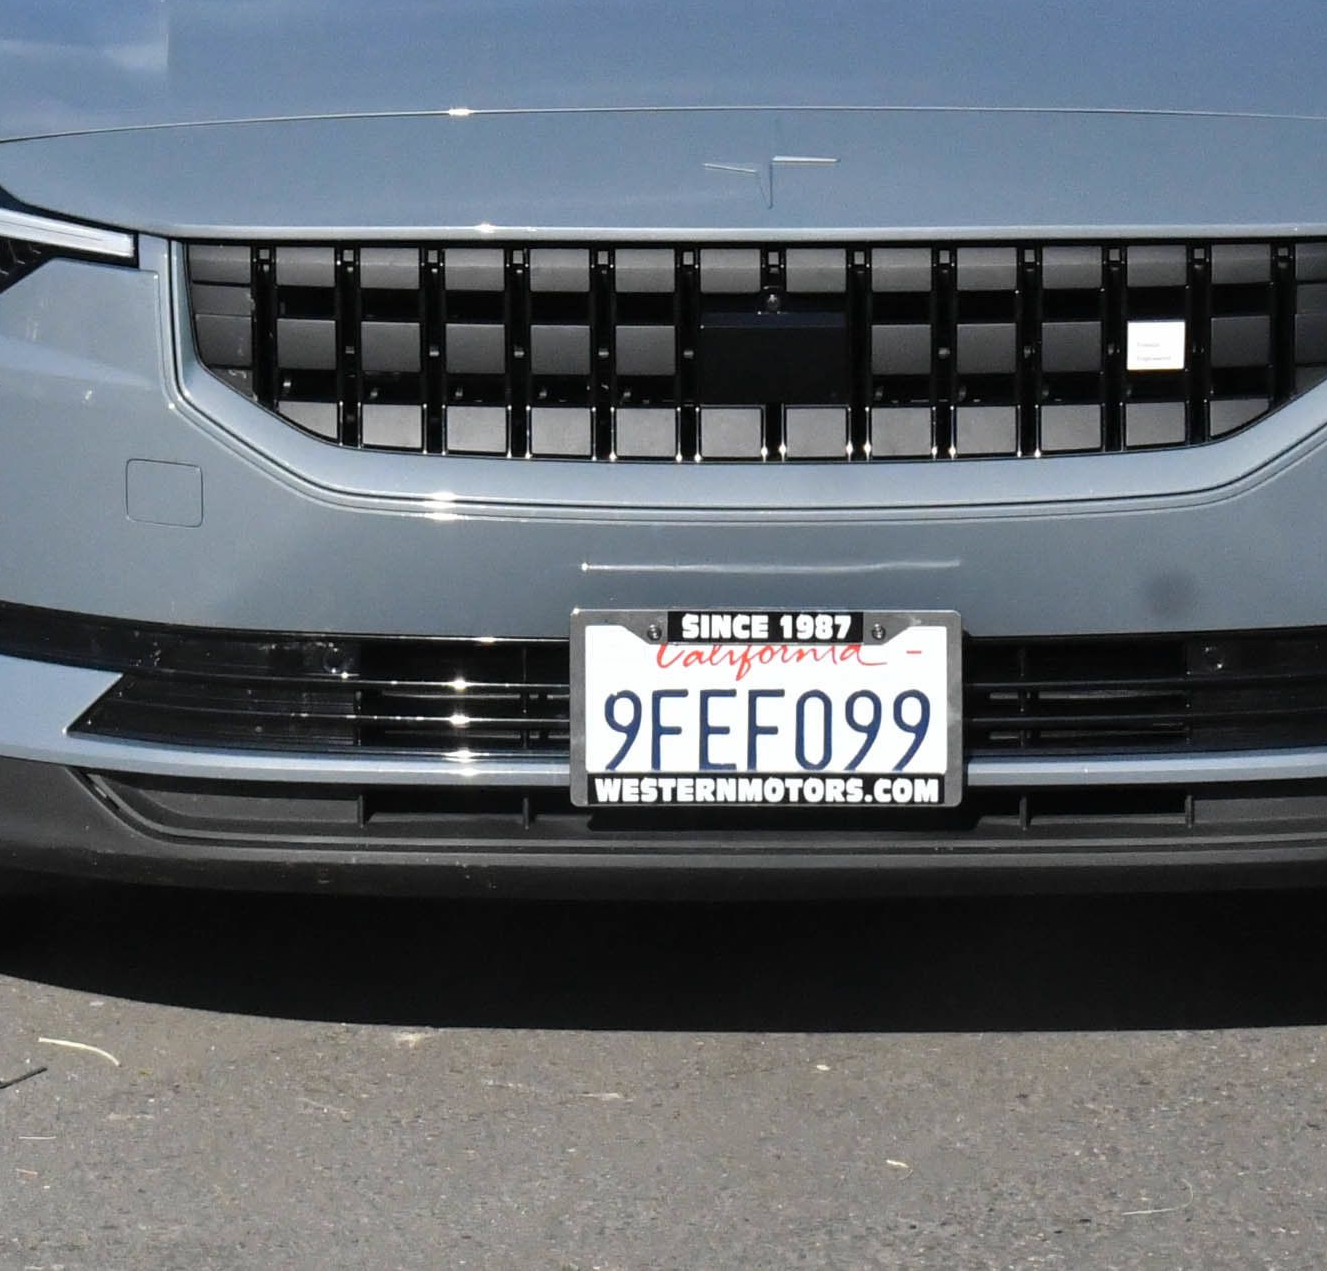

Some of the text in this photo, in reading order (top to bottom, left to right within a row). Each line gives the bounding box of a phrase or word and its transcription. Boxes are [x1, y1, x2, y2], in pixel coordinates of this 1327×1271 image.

[681, 613, 852, 640] SINCE 1987
[603, 688, 931, 772] 9FEF099
[594, 777, 940, 804] WESTERNMOTORS.COM
